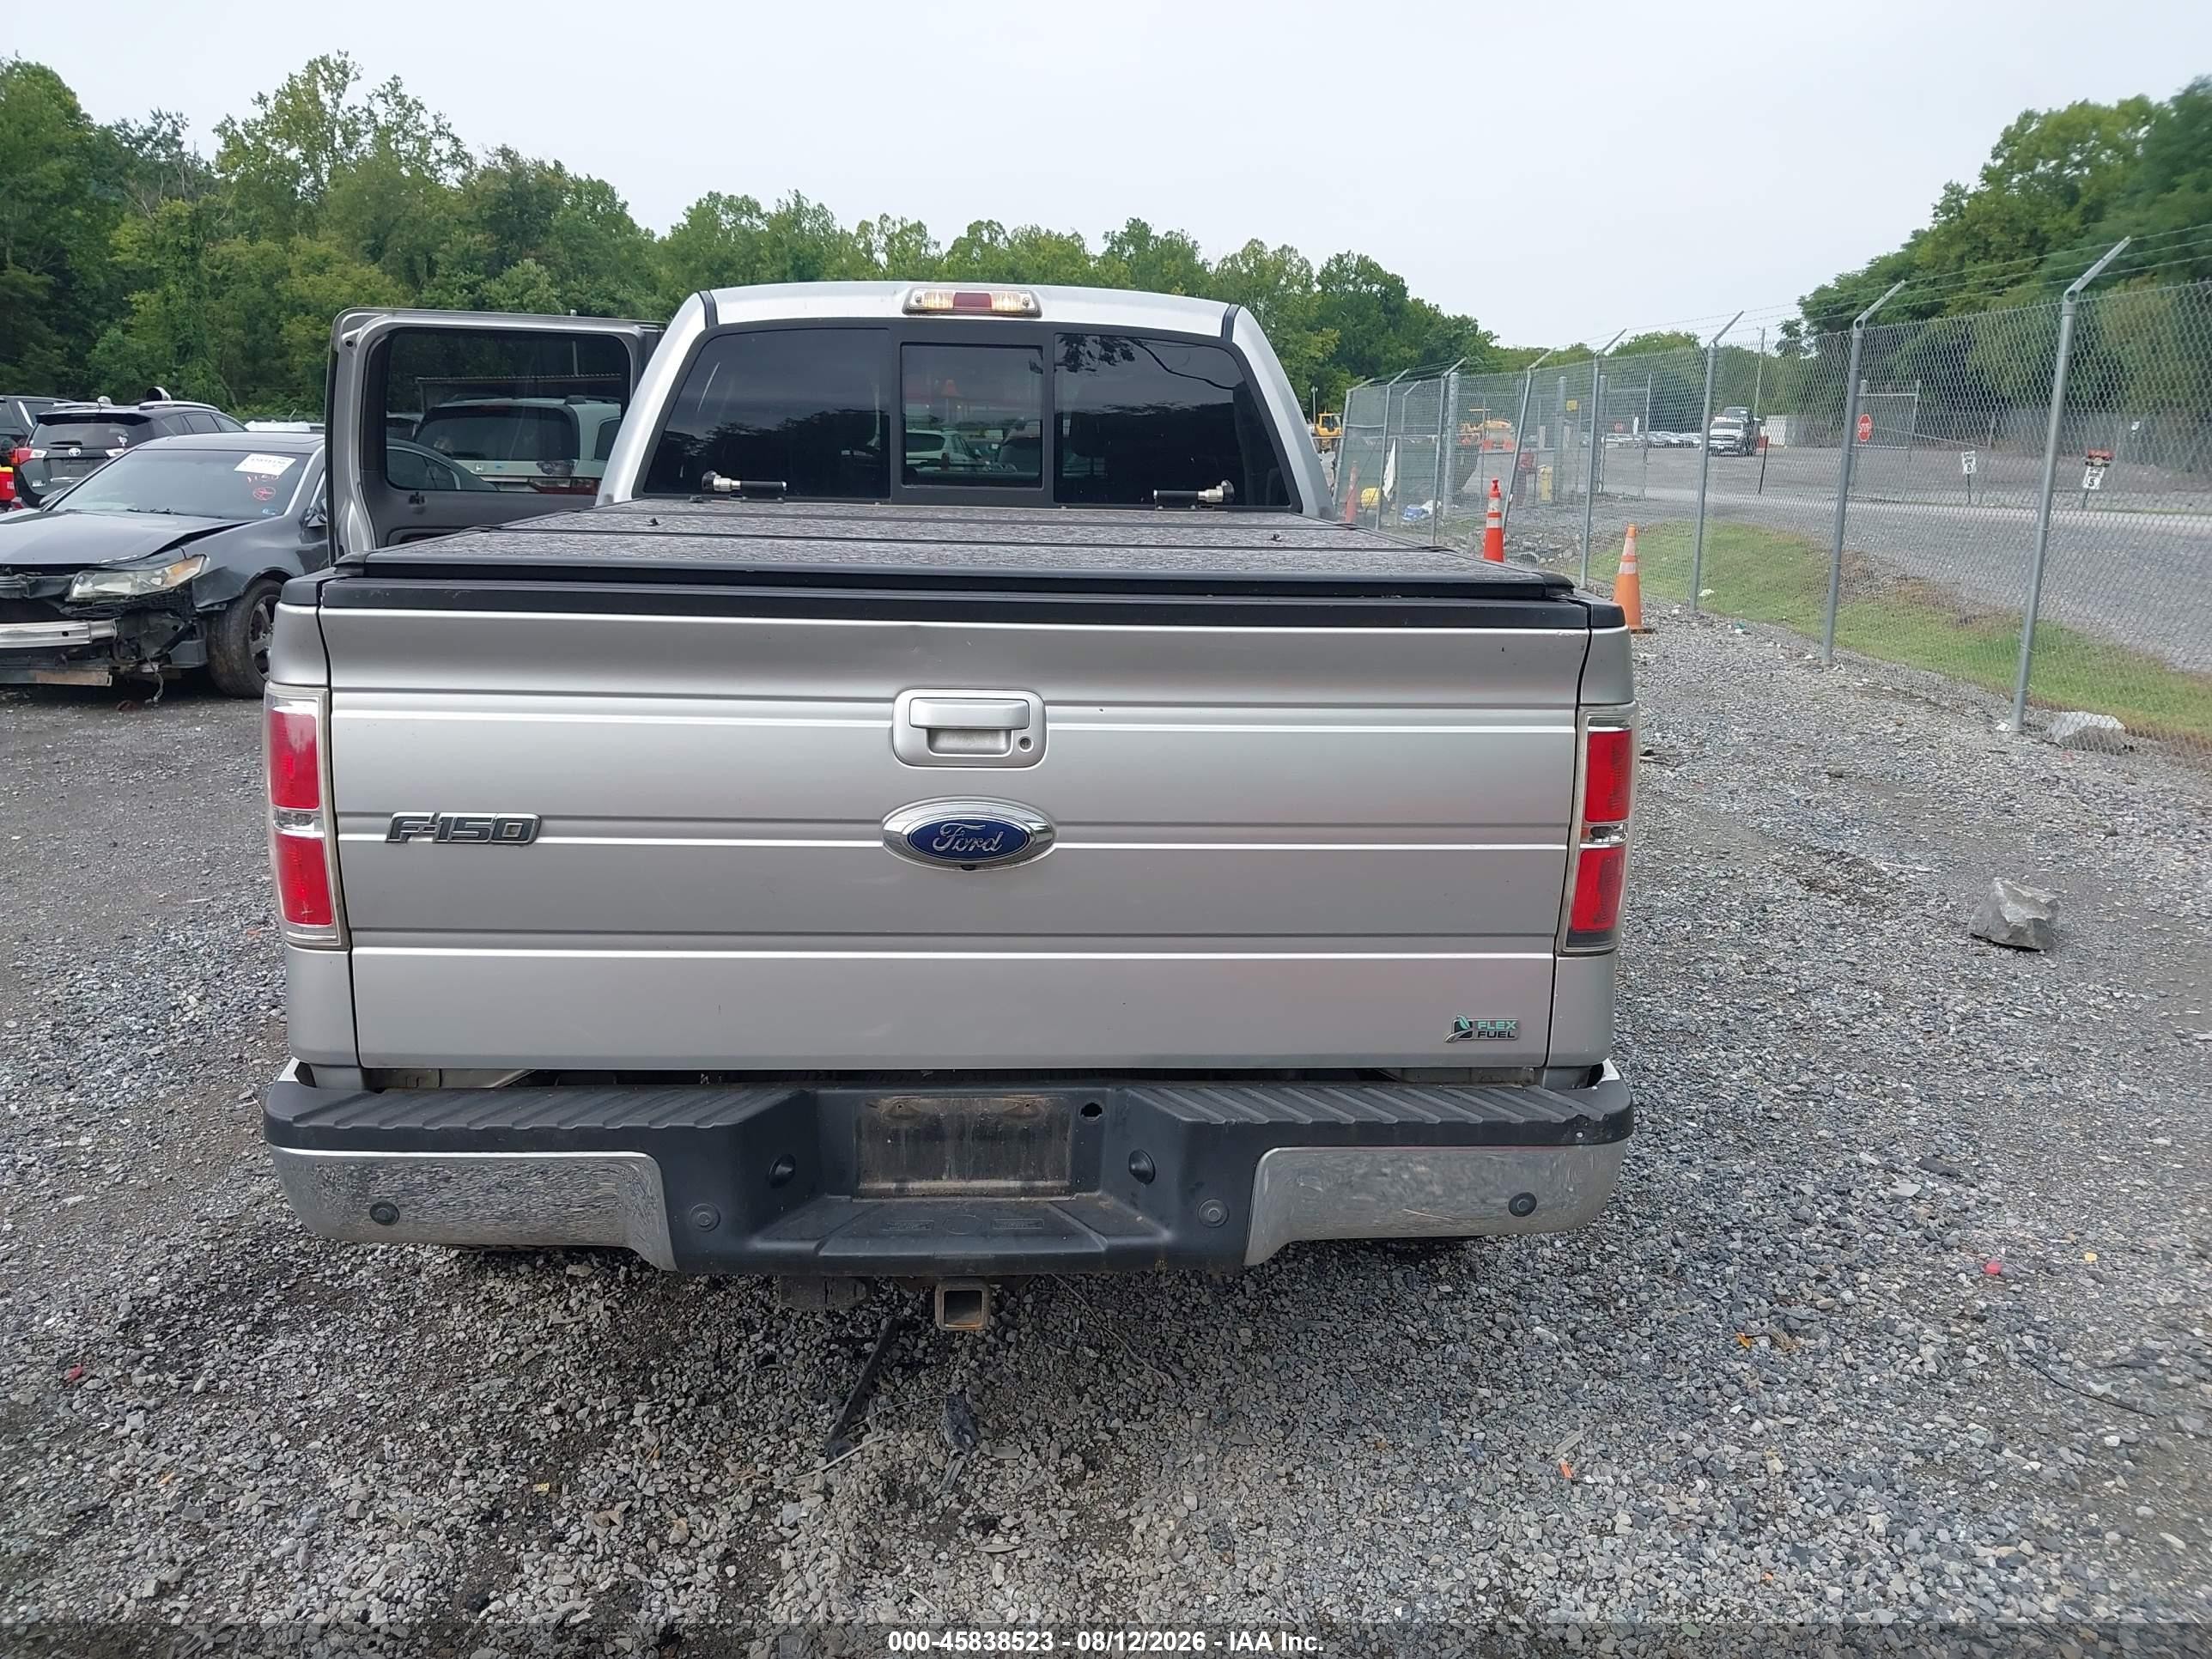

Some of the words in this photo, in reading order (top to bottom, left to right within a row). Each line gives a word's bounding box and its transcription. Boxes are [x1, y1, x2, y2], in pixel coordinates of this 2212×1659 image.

[2088, 477, 2096, 487] 5
[385, 811, 542, 845] F-150
[933, 823, 1003, 852] Ford
[1477, 1021, 1516, 1030] FLEX
